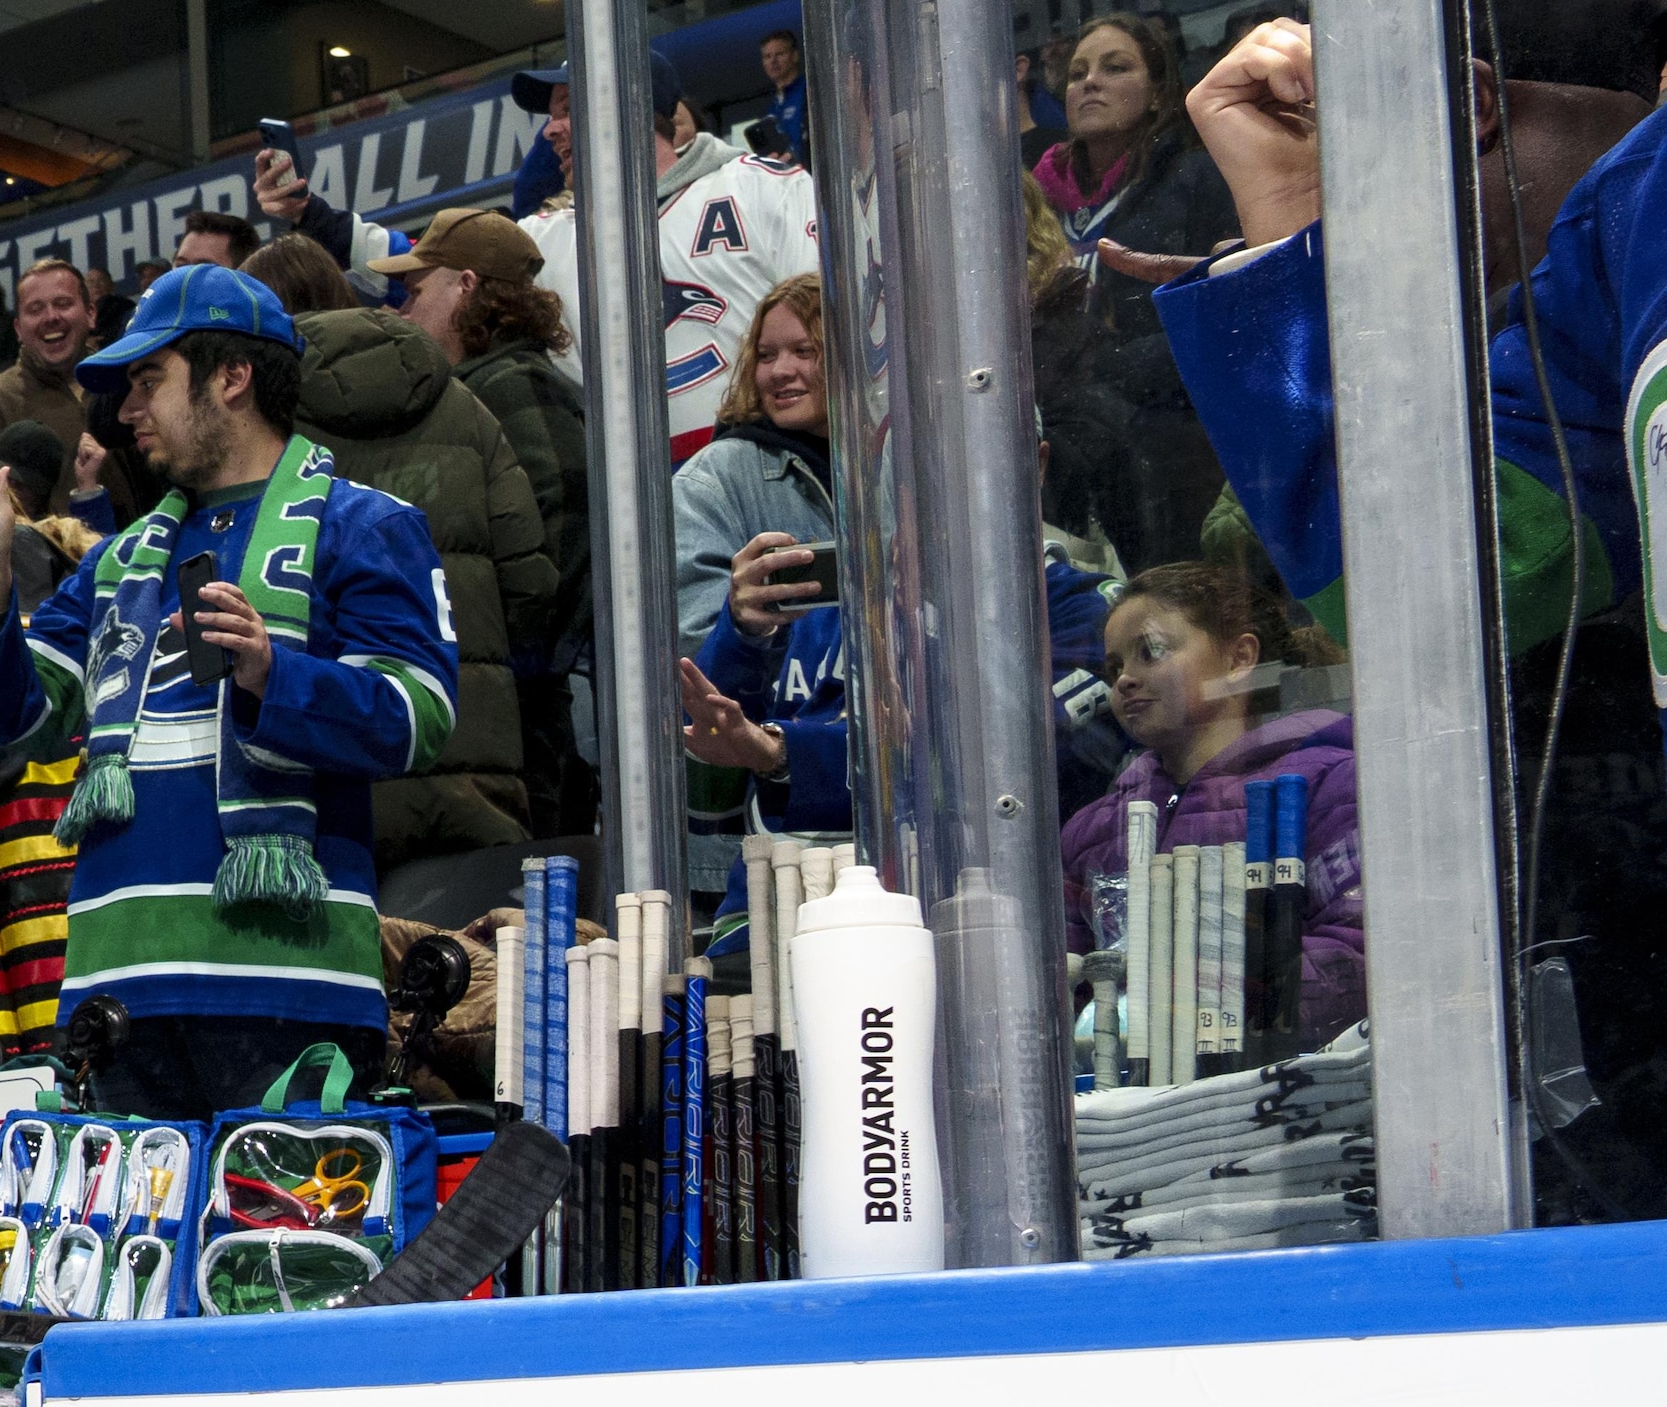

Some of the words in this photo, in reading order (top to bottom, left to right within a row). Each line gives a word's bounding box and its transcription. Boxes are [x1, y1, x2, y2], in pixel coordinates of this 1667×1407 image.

[691, 196, 750, 258] A
[496, 1081, 504, 1096] 6
[861, 1006, 898, 1225] BODYARMOR
[901, 1130, 910, 1168] DRINK
[903, 1173, 913, 1223] SPORTS
